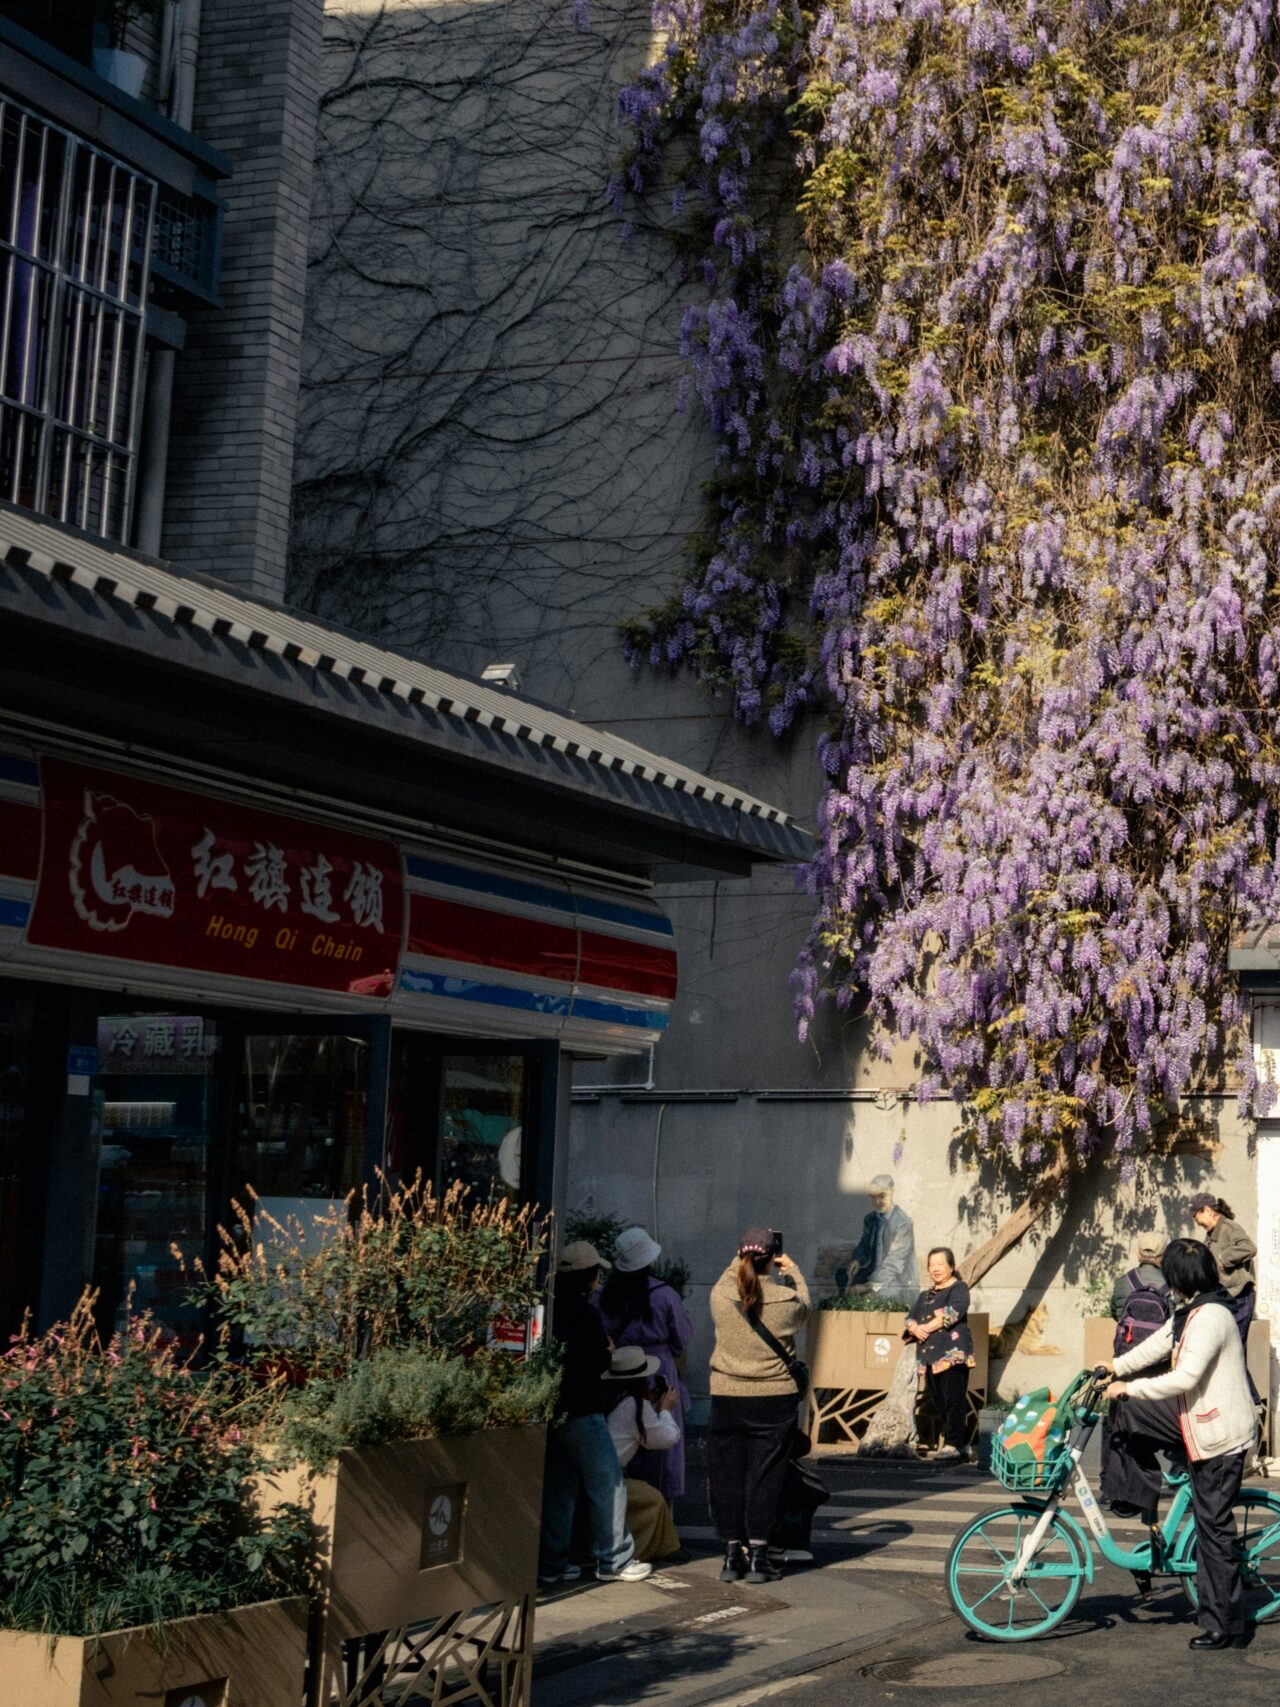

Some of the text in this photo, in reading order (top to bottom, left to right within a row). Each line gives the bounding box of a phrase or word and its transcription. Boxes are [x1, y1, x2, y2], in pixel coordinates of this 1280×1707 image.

[190, 825, 386, 935] 红旗连锁
[205, 913, 363, 962] Hong Qi Chain
